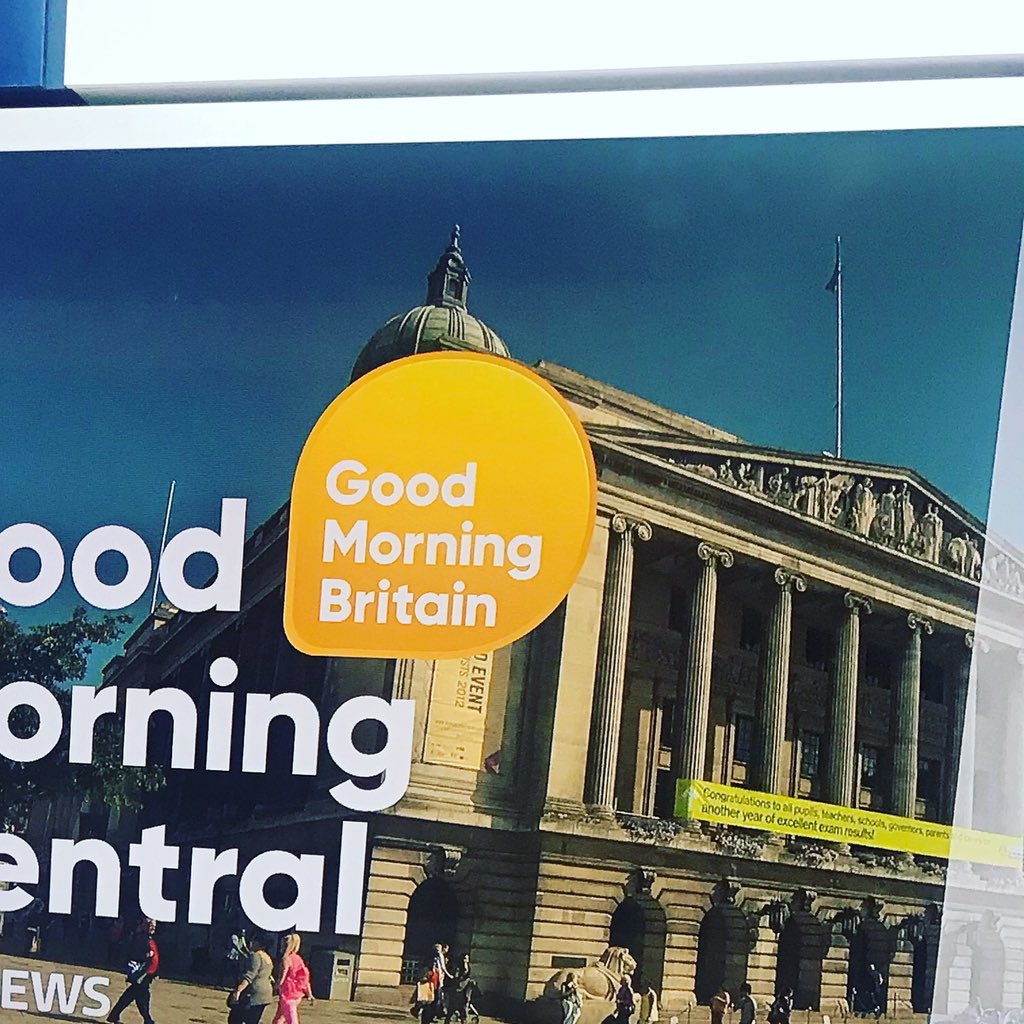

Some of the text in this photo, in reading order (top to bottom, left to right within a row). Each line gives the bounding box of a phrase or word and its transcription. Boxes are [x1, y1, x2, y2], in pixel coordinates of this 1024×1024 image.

[326, 459, 478, 507] Good
[322, 519, 543, 581] Morning
[319, 577, 497, 628] Britain
[454, 681, 467, 709] 2012
[467, 665, 487, 714] EVENT
[701, 803, 741, 819] another
[742, 810, 764, 823] year
[765, 813, 776, 824] of
[777, 816, 818, 831] excellent
[819, 823, 843, 836] exam
[703, 786, 772, 810] Congratulations
[773, 800, 782, 812] to
[783, 803, 793, 812] all
